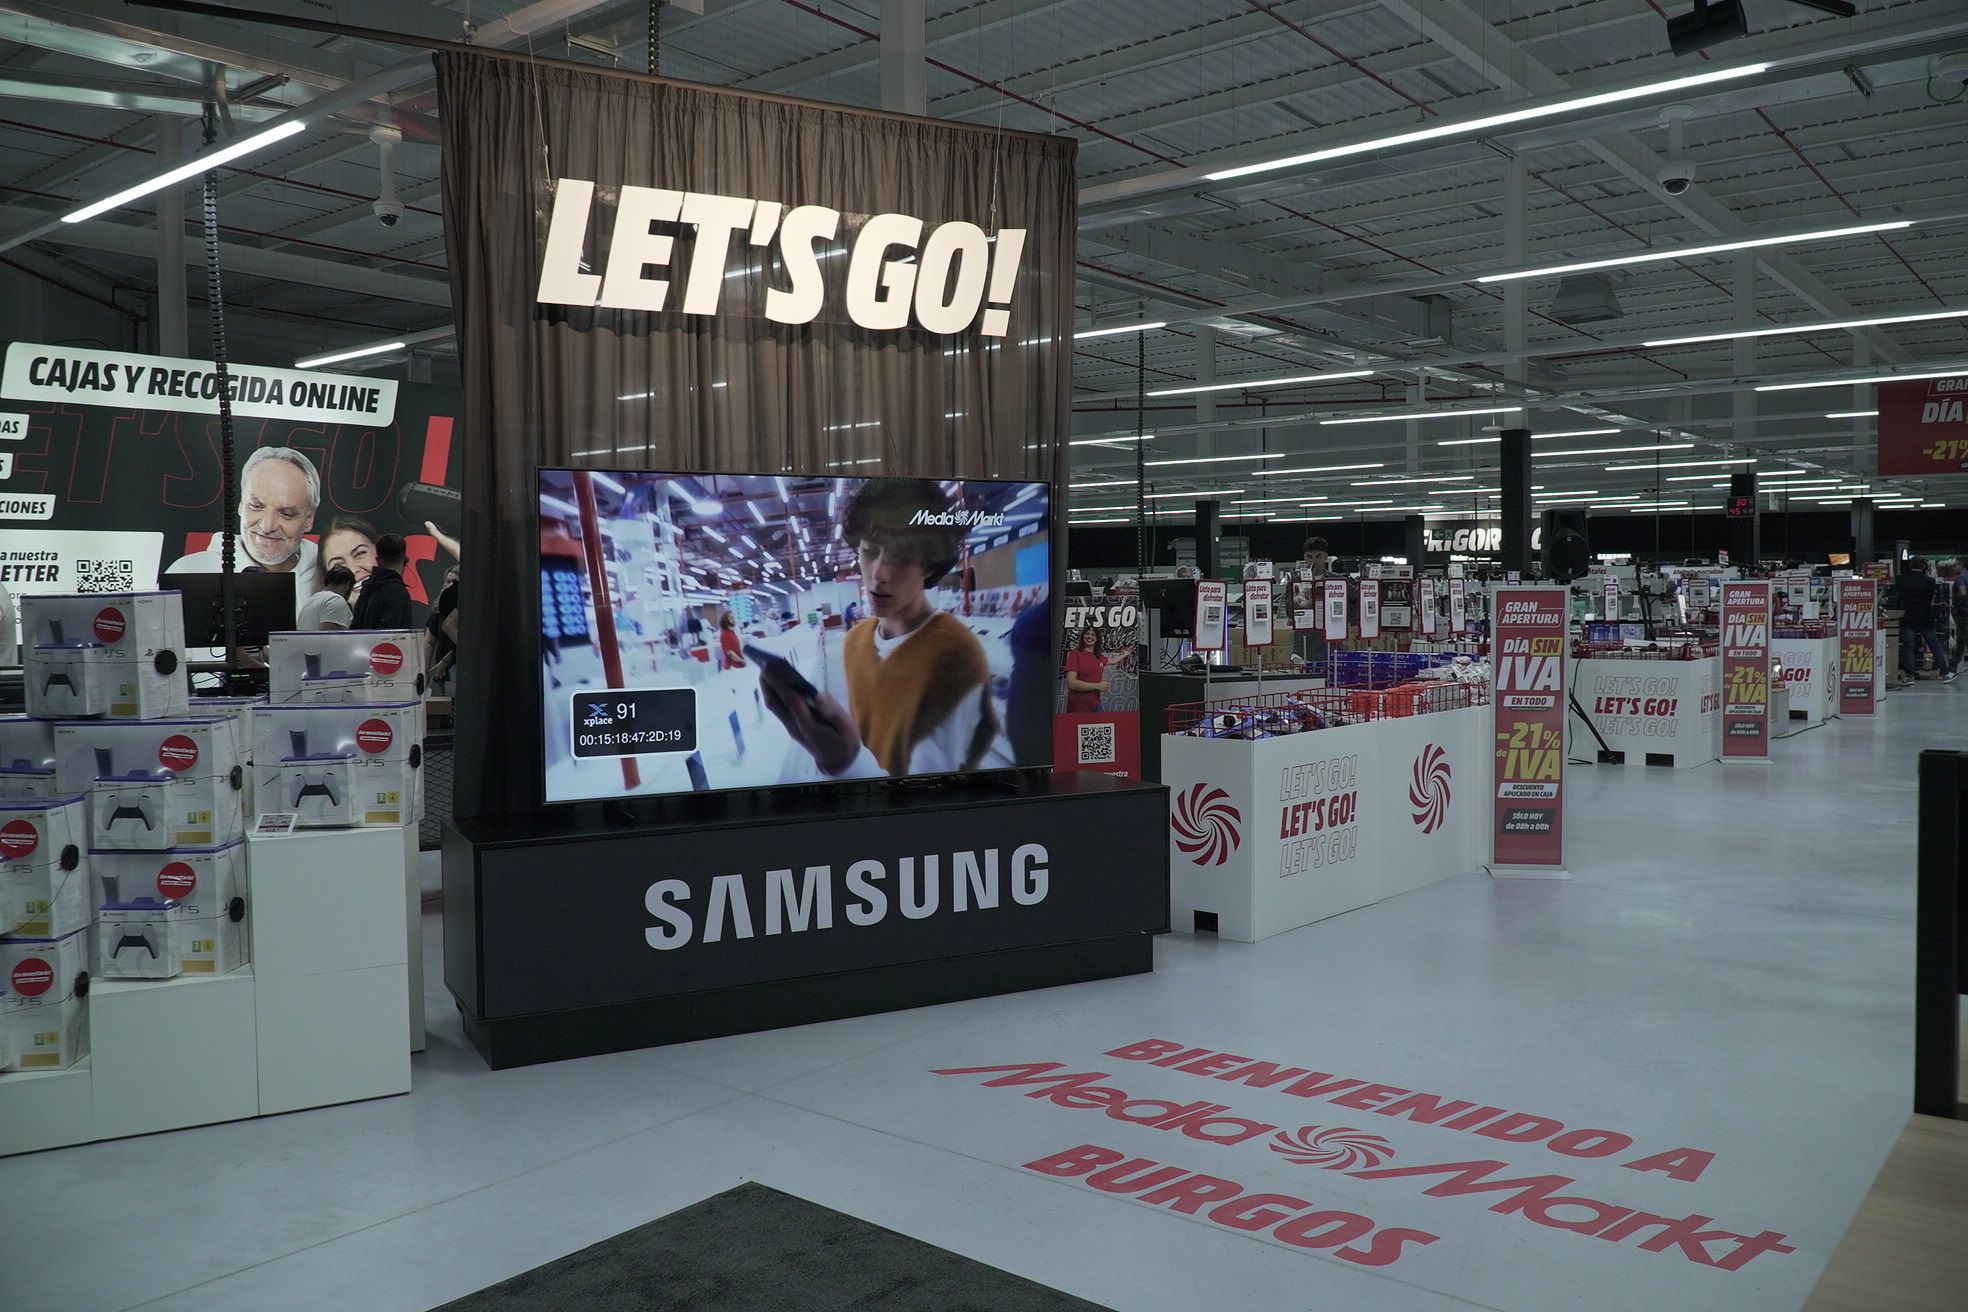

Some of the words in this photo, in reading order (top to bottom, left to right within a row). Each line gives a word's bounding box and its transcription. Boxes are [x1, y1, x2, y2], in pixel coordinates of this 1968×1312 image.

[536, 178, 840, 324] LET'S
[846, 213, 1027, 336] GO!
[29, 357, 118, 392] CAJAS
[124, 365, 146, 393] Y
[148, 367, 283, 405] RECOGIDA
[289, 381, 380, 413] ONLINE
[1921, 397, 1963, 423] DÍA
[0, 420, 19, 434] AS
[909, 509, 954, 525] Media
[966, 510, 1005, 526] Markt
[10, 550, 58, 561] nuestra
[1729, 590, 1751, 598] GRAN
[1108, 605, 1136, 628] GO
[1505, 602, 1538, 613] GRAN
[1502, 613, 1559, 624] APERTURA
[1728, 613, 1745, 624] DÍA
[1748, 614, 1766, 623] SIN
[1841, 612, 1873, 629] IVA
[1503, 637, 1529, 654] DÍA
[1533, 639, 1560, 654] SIN
[1724, 624, 1766, 647] IVA
[1496, 656, 1560, 691] IVA
[1724, 666, 1766, 683] -21%
[1844, 657, 1873, 673] IVA
[1594, 676, 1642, 696] LET'S
[1643, 677, 1679, 697] GO!
[1728, 683, 1766, 704] IVA
[616, 703, 637, 719] 91
[1511, 697, 1523, 705] EN
[1524, 697, 1547, 705] TODO
[1594, 697, 1642, 716] LET'S
[1643, 698, 1678, 717] GO!
[583, 716, 613, 727] xplace
[1595, 716, 1642, 736] LET'S
[1643, 718, 1679, 738] GO!
[579, 730, 682, 746] 00:15:18:47:2D:19
[1497, 722, 1560, 749] -21%
[1496, 749, 1508, 758] de
[1503, 749, 1561, 780] IVA
[1279, 760, 1326, 802] LET'S
[1327, 754, 1358, 791] GO!
[1280, 798, 1326, 840] LET'S
[1327, 790, 1358, 828] GO!
[1529, 812, 1544, 820] HOY
[1505, 822, 1515, 830] de
[1279, 833, 1326, 879] LET'S
[1327, 826, 1358, 865] GO!
[644, 843, 1050, 951] SAMSUNG
[1101, 1038, 1633, 1158] BIENVENIDO
[1620, 1147, 1716, 1183] A
[928, 1062, 1279, 1146] Media
[1342, 1159, 1797, 1272] Markt
[1020, 1144, 1441, 1267] BURGOS
